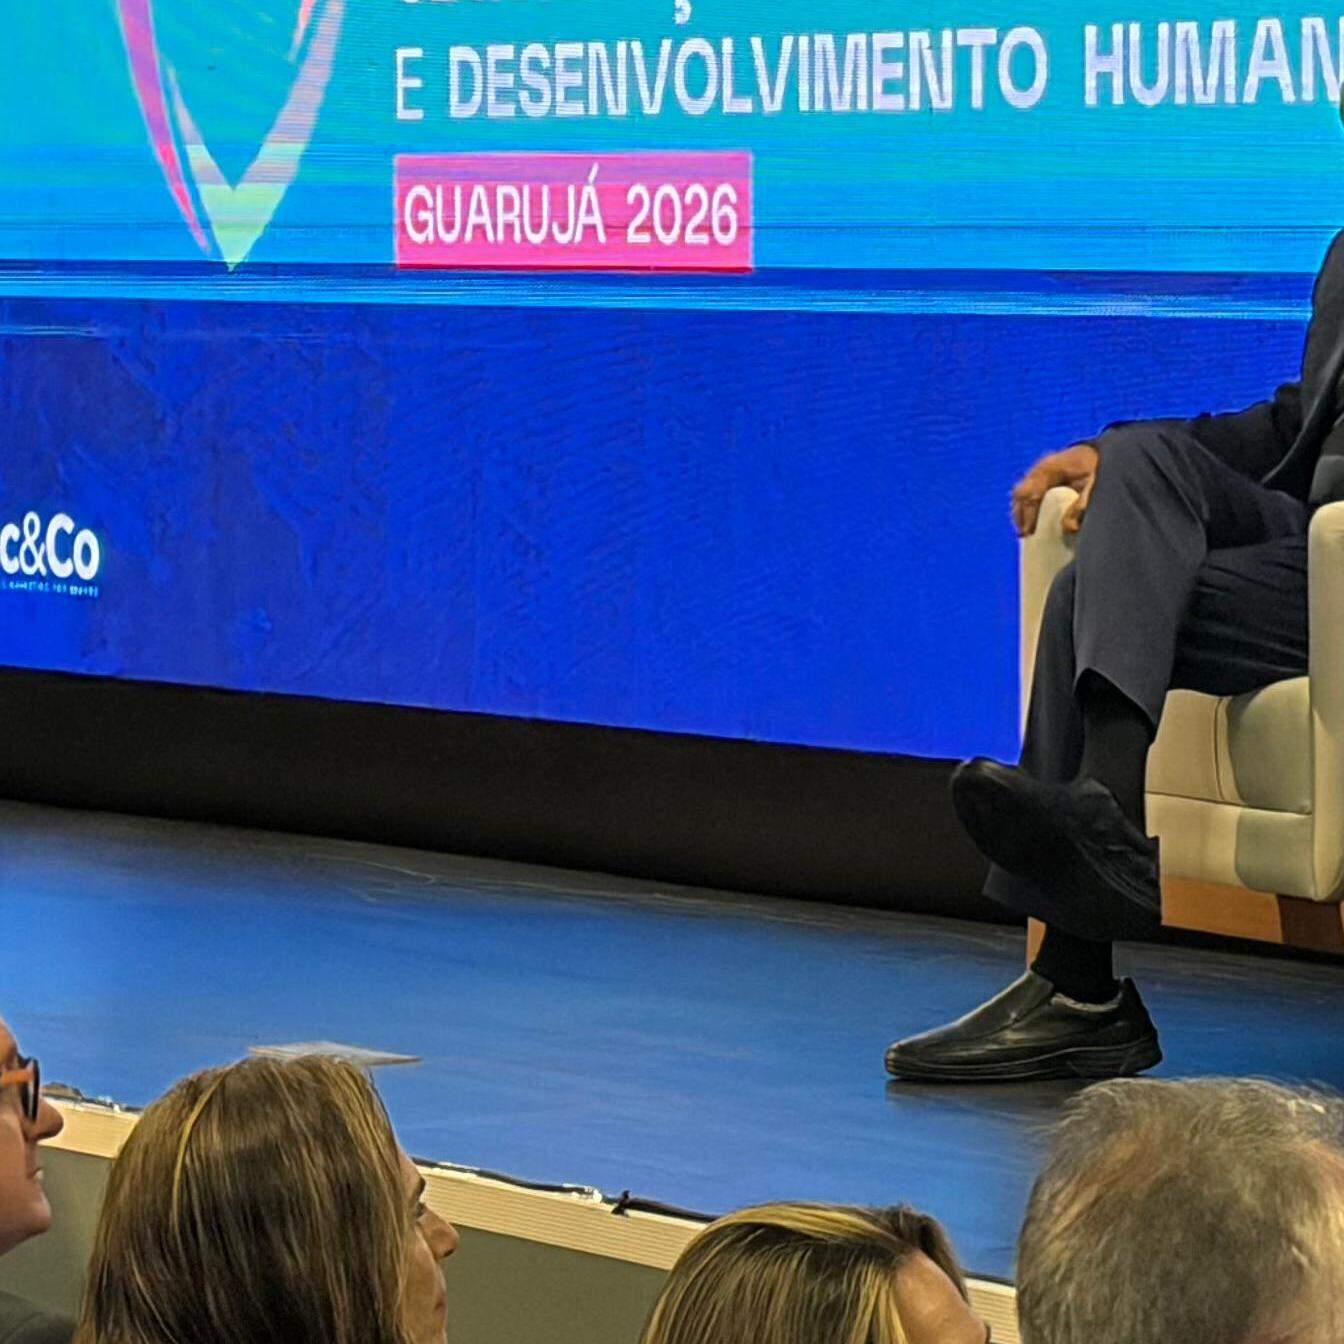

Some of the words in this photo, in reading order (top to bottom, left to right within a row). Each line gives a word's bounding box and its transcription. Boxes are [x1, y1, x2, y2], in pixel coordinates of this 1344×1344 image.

[395, 47, 425, 121] E
[448, 26, 1049, 120] DESENVOLVIMENTO
[403, 161, 607, 245] GUARUJÁ
[625, 181, 739, 246] 2026
